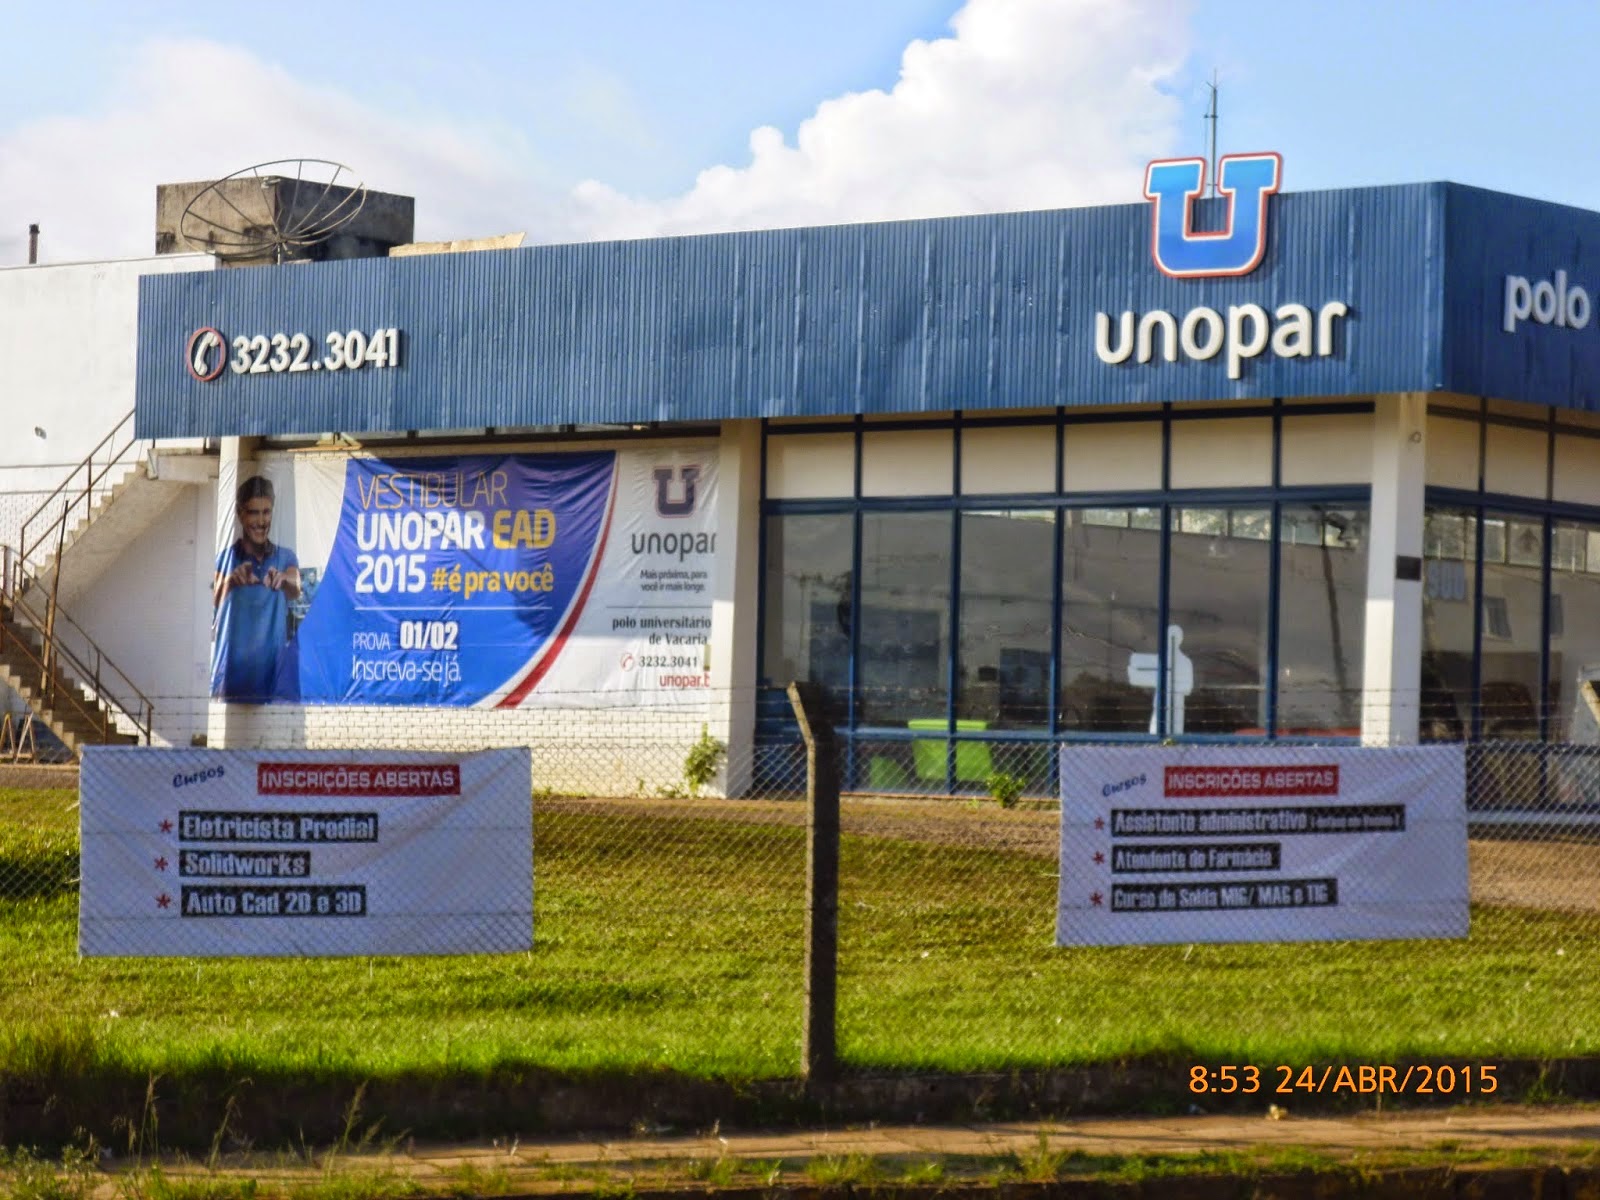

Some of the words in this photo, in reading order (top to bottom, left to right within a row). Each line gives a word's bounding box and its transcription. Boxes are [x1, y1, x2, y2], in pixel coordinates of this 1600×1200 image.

[1503, 269, 1591, 334] polo
[230, 327, 399, 374] 3232.3041
[1095, 301, 1348, 380] unopar
[357, 471, 508, 510] VESTIBULAR
[356, 510, 486, 550] UNOPAR
[492, 508, 557, 549] EAD
[631, 531, 717, 562] unopar
[355, 553, 427, 594] 2015
[431, 563, 462, 592] #é
[464, 570, 501, 600] pra
[503, 562, 555, 592] você
[665, 582, 683, 592] mais
[690, 571, 708, 582] para
[352, 632, 391, 651] PROVA
[399, 620, 459, 651] 01/02
[612, 616, 637, 631] polo
[640, 616, 712, 629] universitário
[649, 633, 662, 645] de
[665, 633, 708, 645] Vacaria
[352, 655, 442, 681] Inscreva-se
[638, 655, 698, 668] 3232.3041
[172, 765, 226, 788] Cursos
[261, 767, 371, 793] INSCRIÇÕES
[373, 769, 455, 788] ABERTAS
[1167, 769, 1262, 793] INSCRIÇÕES
[1264, 769, 1335, 787] ABERTAS
[182, 815, 295, 841] Eletricista
[299, 815, 375, 840] Predial
[1198, 810, 1308, 831] administrativo
[184, 851, 306, 876] Solidworks
[186, 892, 236, 915] Auto
[241, 891, 280, 914] Cad
[285, 891, 312, 913] 2D
[335, 891, 362, 913] 3D
